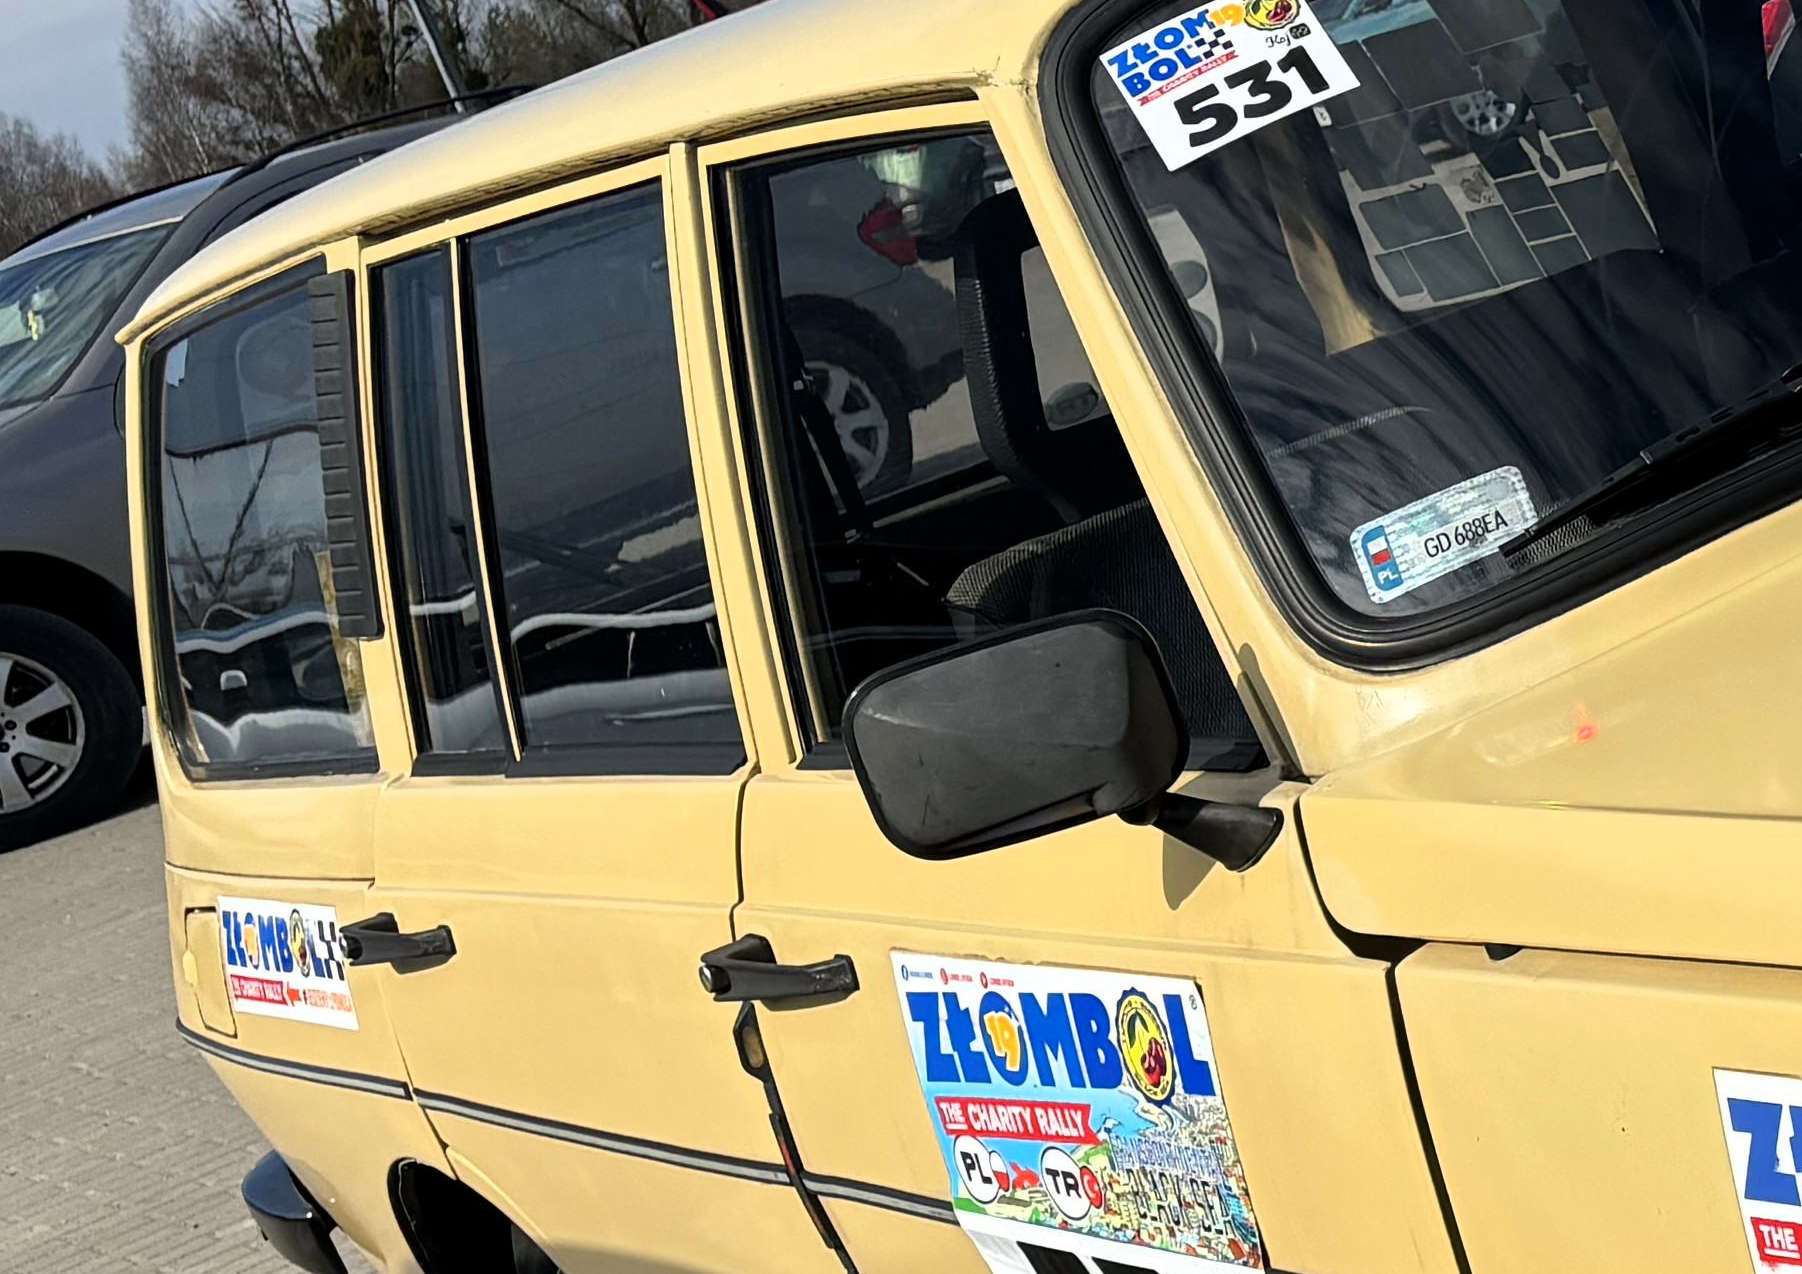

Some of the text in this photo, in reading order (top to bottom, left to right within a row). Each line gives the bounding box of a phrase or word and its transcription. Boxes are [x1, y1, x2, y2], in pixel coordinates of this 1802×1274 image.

[1107, 8, 1216, 79] ZŁOM
[1121, 47, 1203, 98] BOL
[1173, 45, 1330, 148] 531
[1424, 509, 1508, 558] GD 688EA
[1378, 567, 1398, 585] PL
[940, 1102, 1085, 1136] THE CHARITY RALLY
[960, 1151, 993, 1185] PL
[1045, 1168, 1082, 1198] TR
[1759, 1224, 1800, 1259] THE
